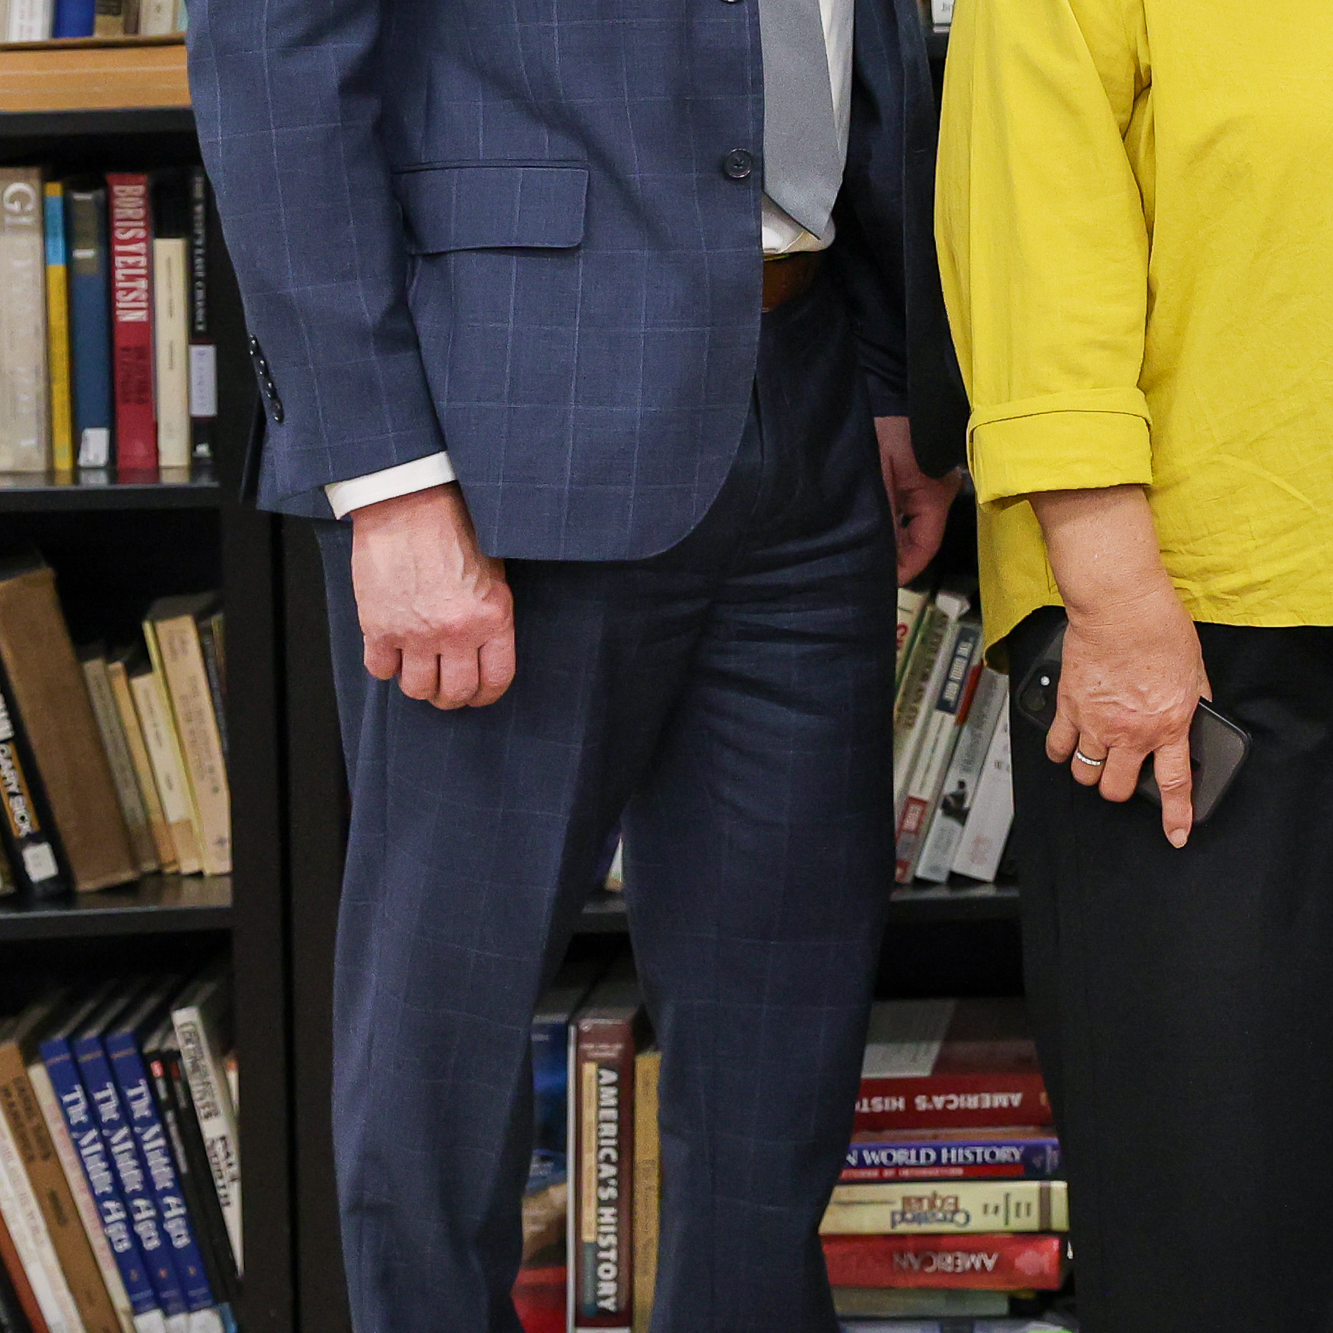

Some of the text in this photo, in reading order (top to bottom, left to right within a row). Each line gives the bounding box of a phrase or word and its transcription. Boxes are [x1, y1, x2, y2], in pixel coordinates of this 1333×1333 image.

[112, 184, 147, 241] BORIS
[114, 241, 149, 323] YELTSIN
[855, 1092, 1023, 1113] AMERICA'S HIST
[61, 1084, 132, 1253] The Middle Ages
[92, 1081, 162, 1251] The Middle Ages
[126, 1078, 191, 1249] The Middle Ages
[596, 1068, 619, 1314] AMERICA'S HISTORY
[862, 1147, 938, 1167] WORLD
[940, 1146, 1024, 1166] HISTORY
[890, 1209, 972, 1230] Created
[892, 1251, 1000, 1273] AMERICAN
